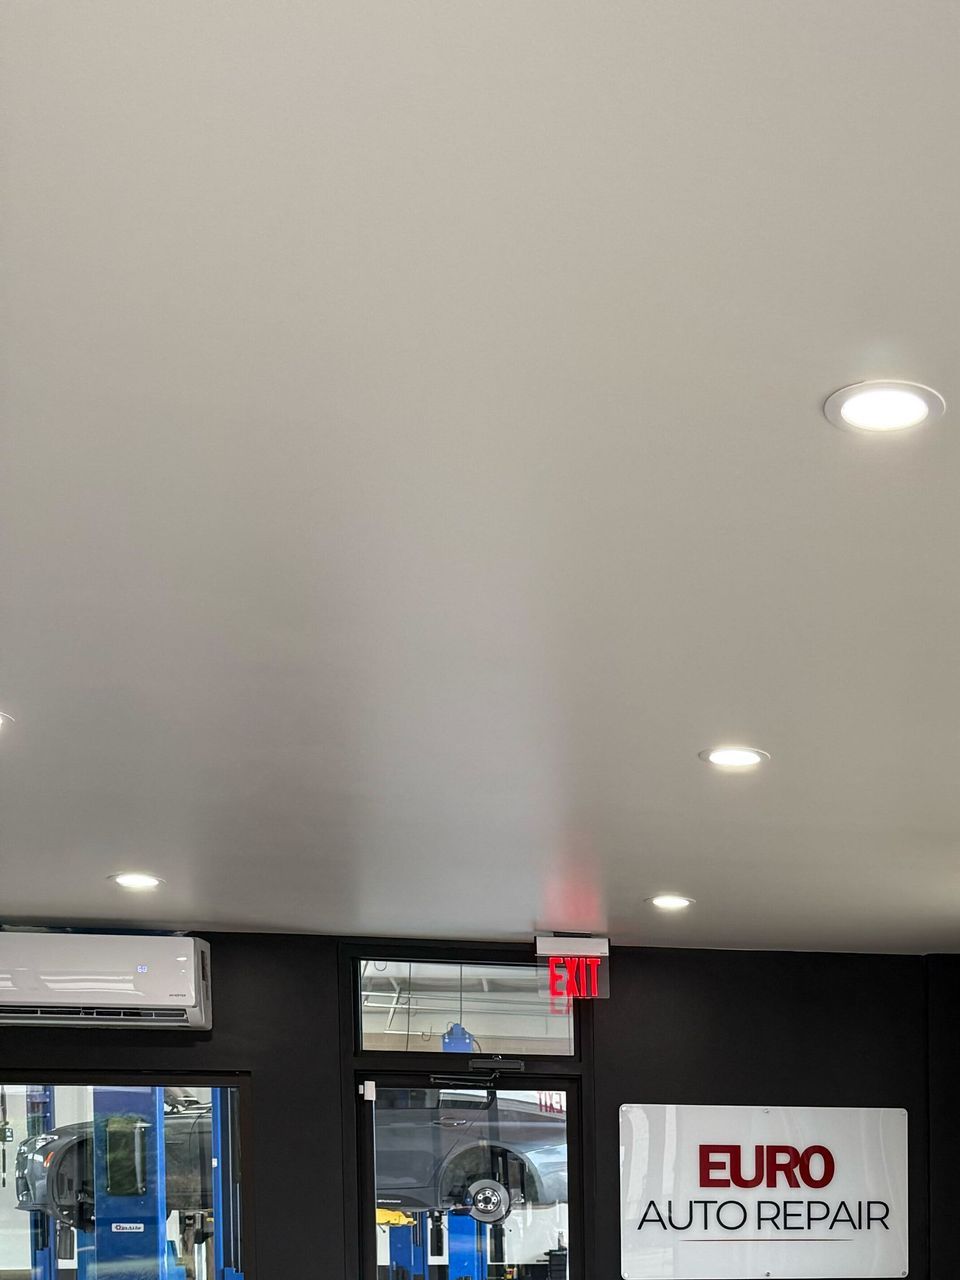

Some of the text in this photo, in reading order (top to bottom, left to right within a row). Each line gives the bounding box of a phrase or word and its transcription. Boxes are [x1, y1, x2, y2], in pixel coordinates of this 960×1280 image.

[548, 957, 600, 997] EXIT
[699, 1144, 835, 1189] EURO
[637, 1200, 890, 1231] AUTO REPAIR
